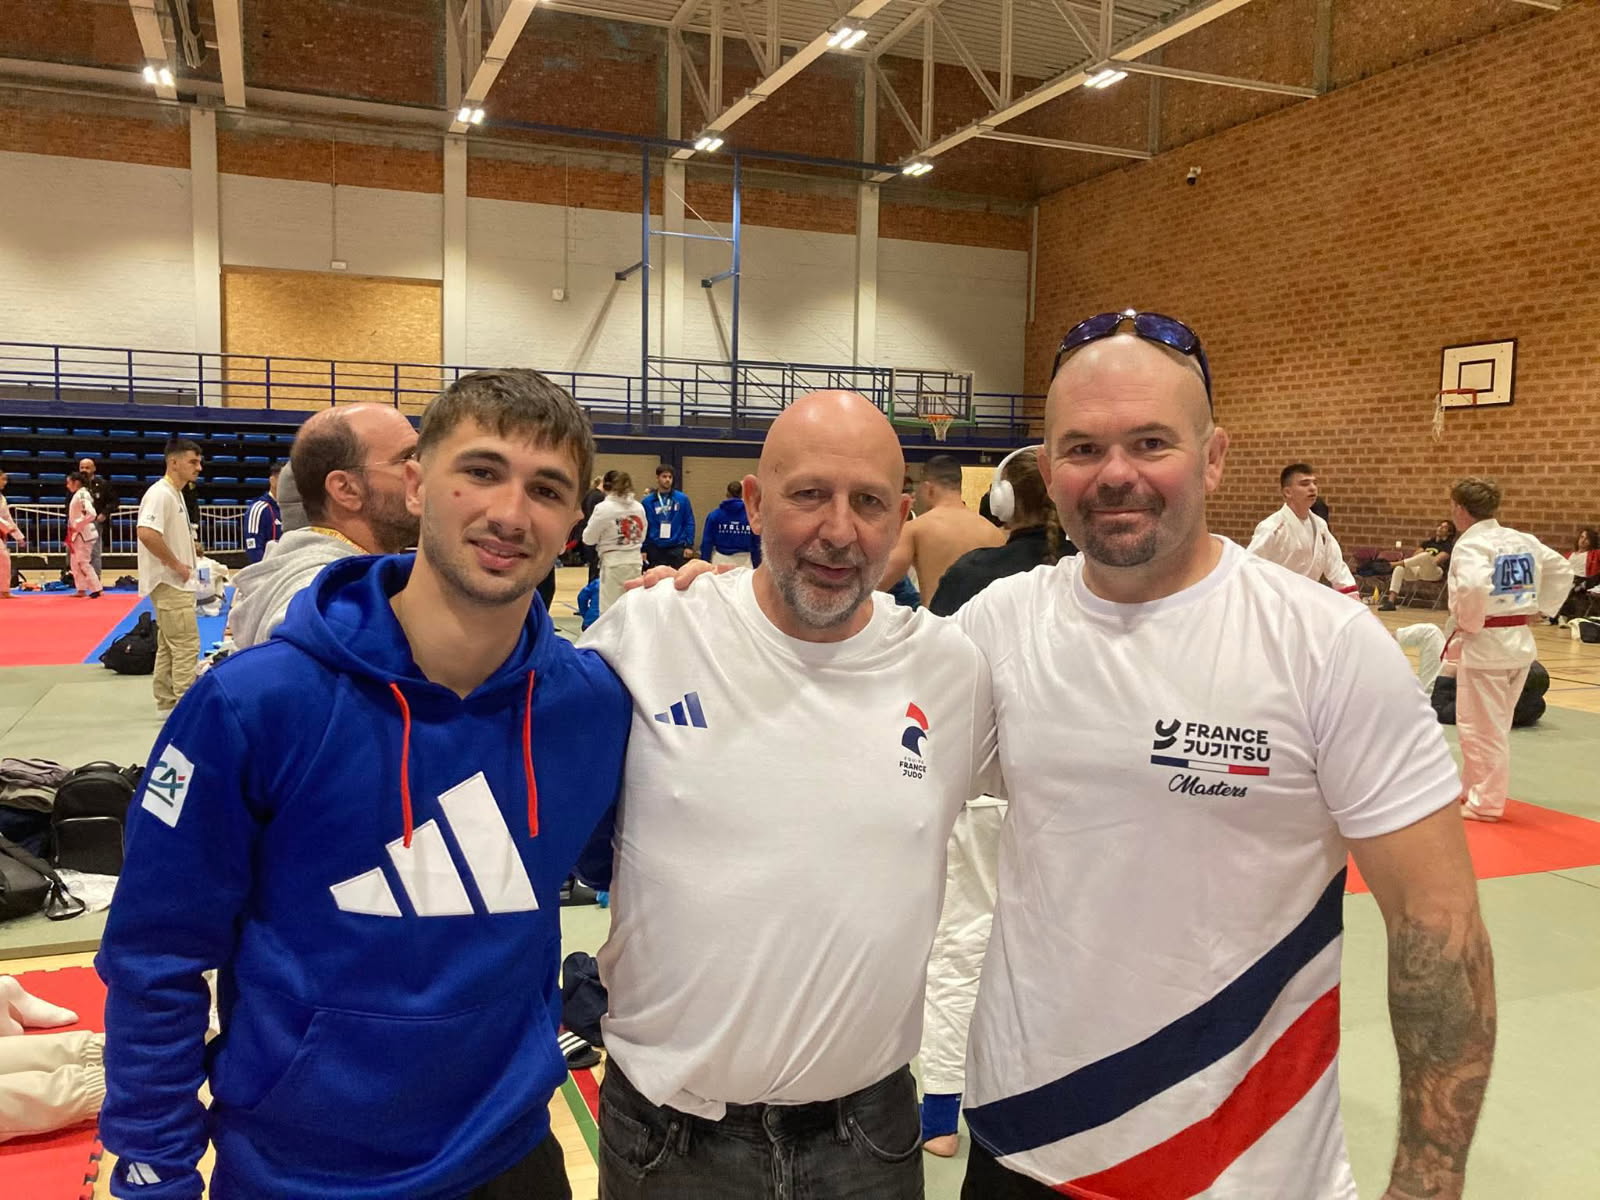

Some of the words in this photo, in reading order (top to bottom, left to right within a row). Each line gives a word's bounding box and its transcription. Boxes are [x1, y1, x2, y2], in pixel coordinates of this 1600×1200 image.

[1502, 558, 1534, 586] GER
[1185, 722, 1269, 745] FRANCE
[1183, 739, 1271, 762] JUJITSU
[899, 761, 927, 773] FRANCE
[902, 769, 923, 780] JUDO
[1169, 774, 1248, 798] Masters
